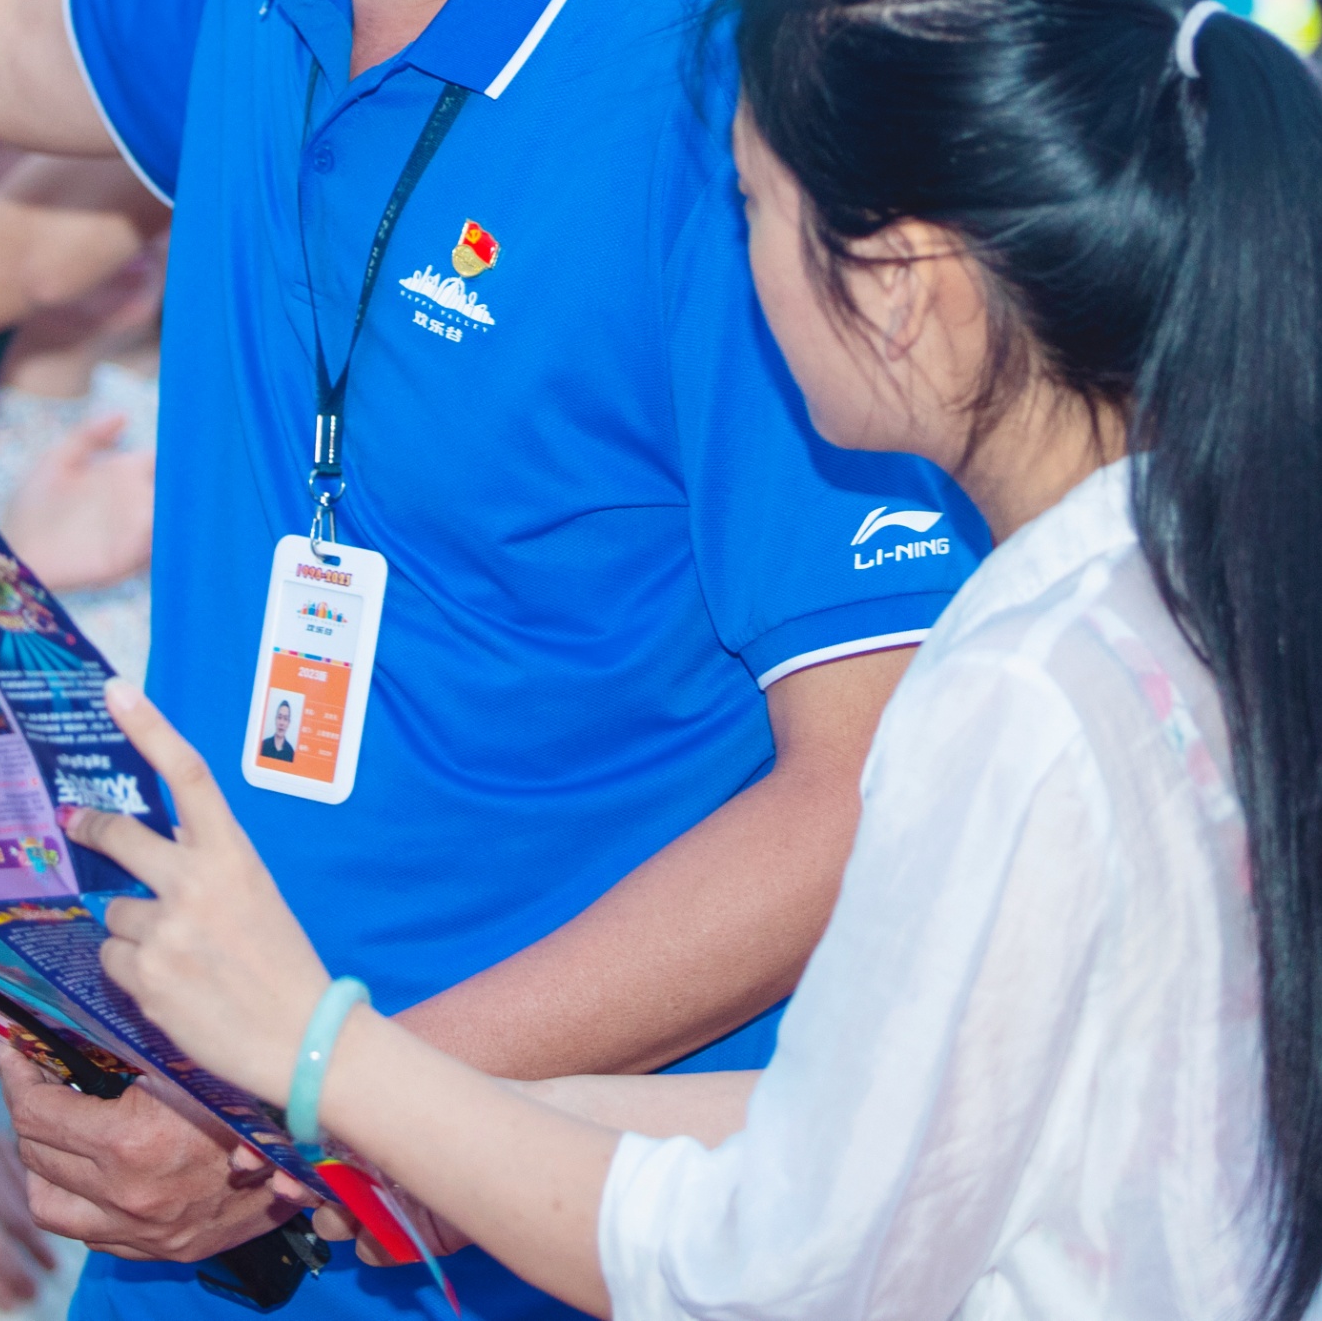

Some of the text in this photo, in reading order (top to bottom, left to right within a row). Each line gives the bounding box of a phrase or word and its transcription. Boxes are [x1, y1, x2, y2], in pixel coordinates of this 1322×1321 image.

[412, 310, 463, 343] 欢乐谷
[441, 309, 488, 333] VALLEY
[854, 538, 950, 570] LI-NING
